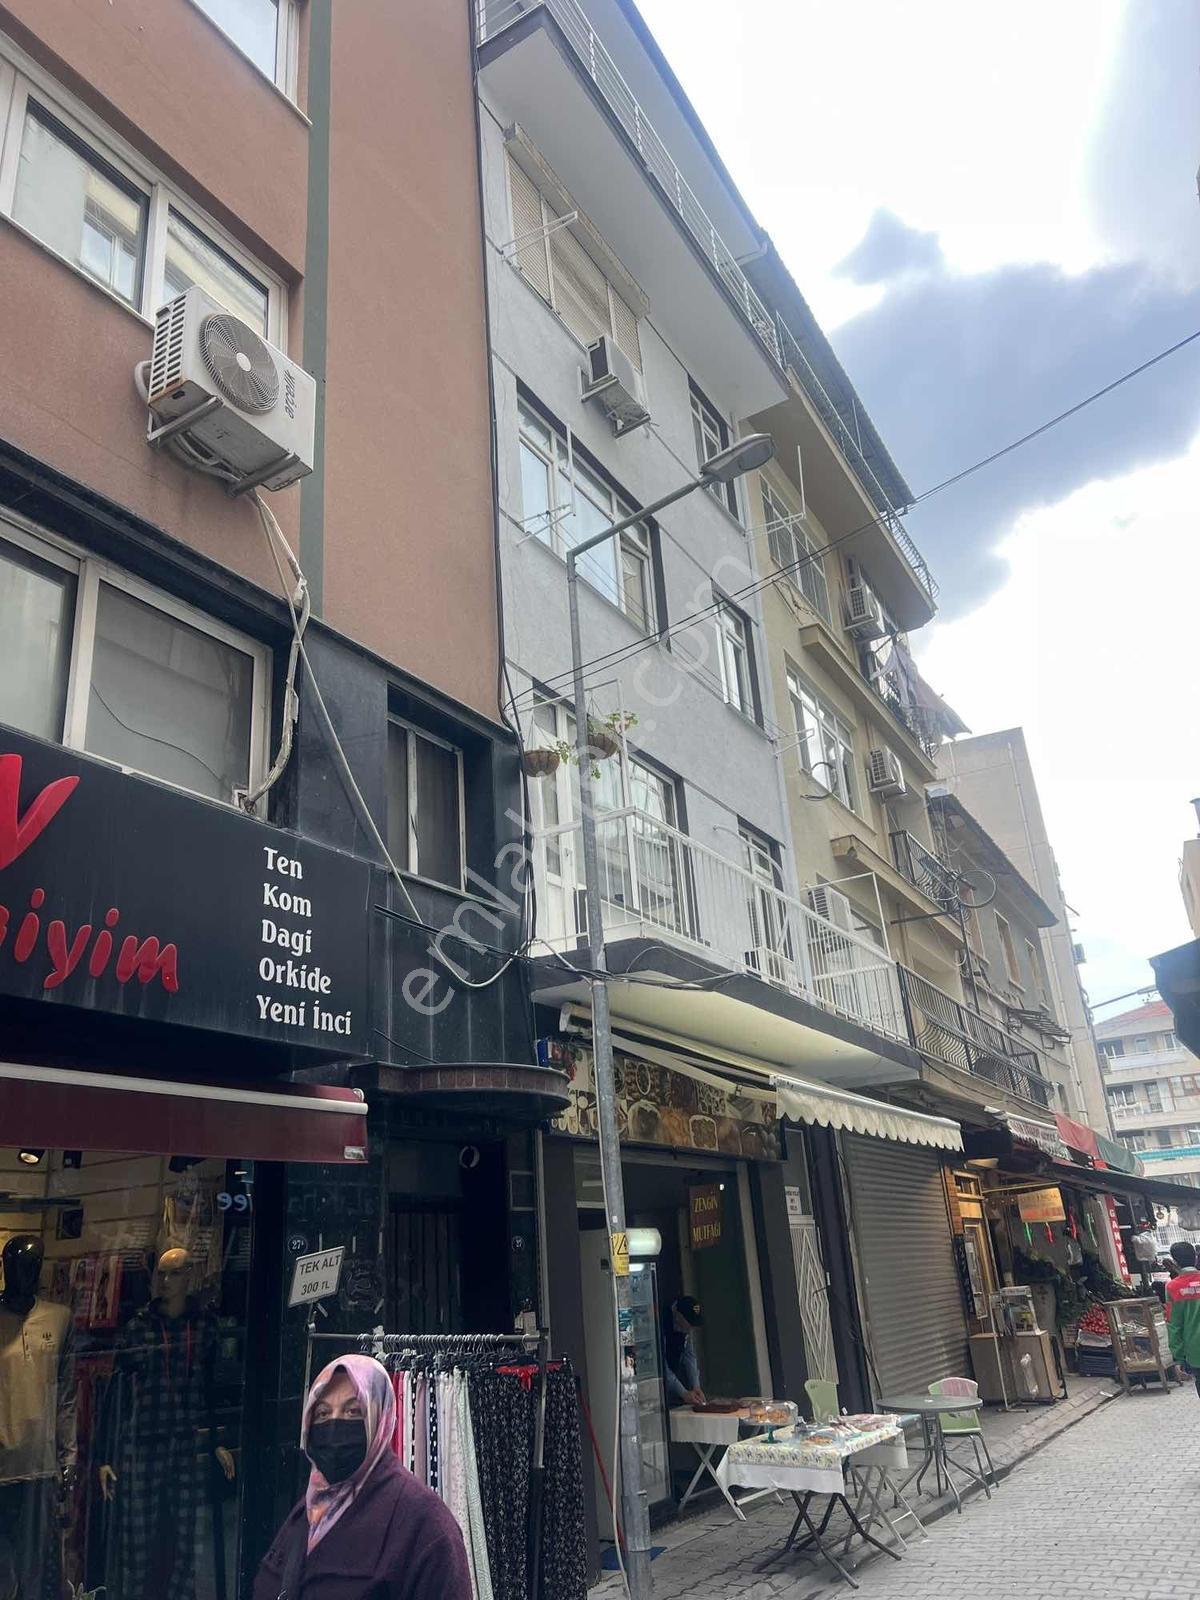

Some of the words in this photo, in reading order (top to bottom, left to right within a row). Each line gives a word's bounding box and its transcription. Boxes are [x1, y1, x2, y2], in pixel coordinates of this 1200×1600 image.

[263, 847, 303, 879] Ten
[263, 883, 312, 917] Kom
[0, 887, 179, 993] iyim
[261, 919, 312, 957] Dagi
[259, 957, 332, 994] Orkide
[256, 994, 305, 1027] Yeni
[300, 1259, 320, 1275] TEK
[322, 1255, 341, 1269] ALT
[301, 1282, 318, 1296] 300
[321, 1281, 330, 1289] TL
